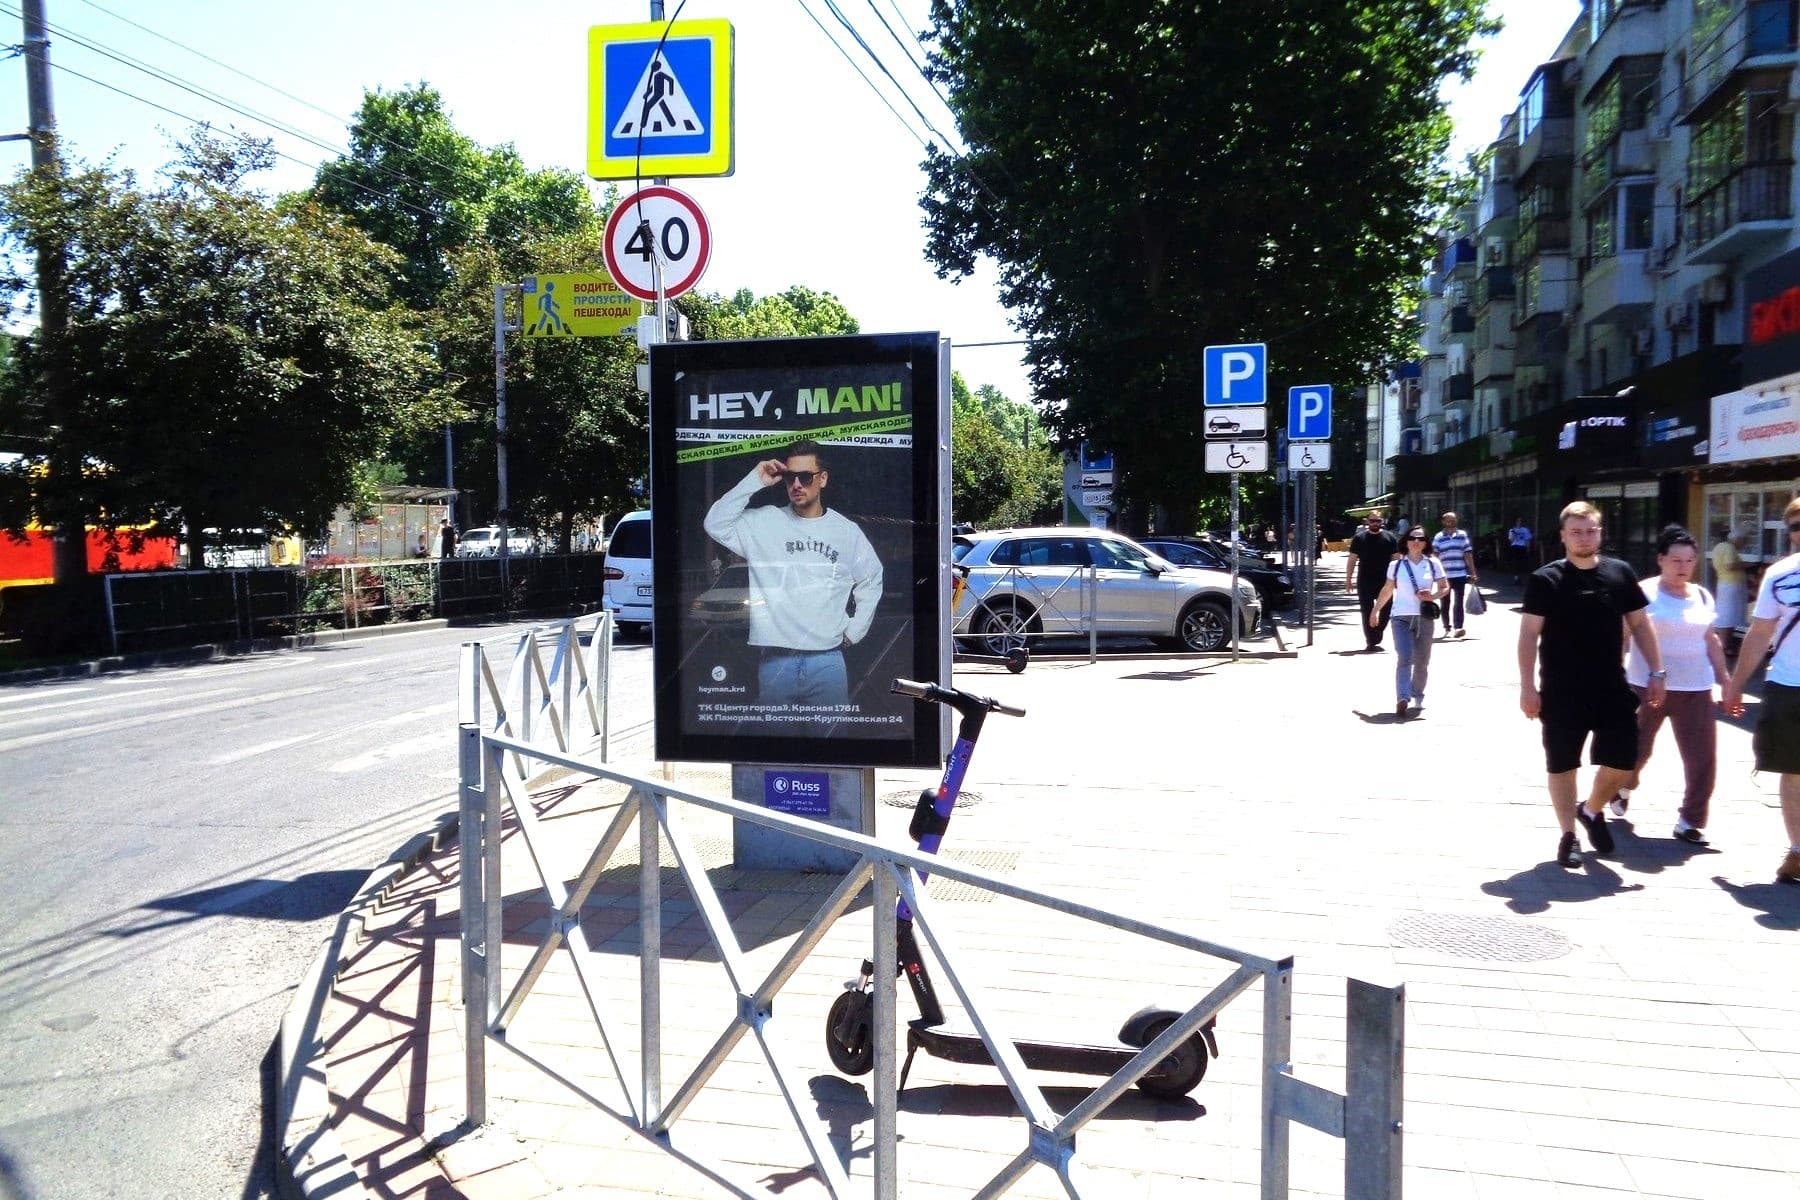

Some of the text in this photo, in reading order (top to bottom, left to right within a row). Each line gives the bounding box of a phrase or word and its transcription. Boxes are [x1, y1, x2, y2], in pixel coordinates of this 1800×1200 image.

[624, 217, 690, 261] 40
[573, 294, 631, 305] ПРОПУСТИ
[573, 307, 631, 318] ПЕШЕХОДА!
[1222, 352, 1256, 399] P
[689, 382, 902, 421] HEY, MAN!
[1300, 392, 1323, 433] P
[791, 704, 833, 713] Красная
[889, 715, 903, 723] 24
[791, 780, 820, 792] Russ
